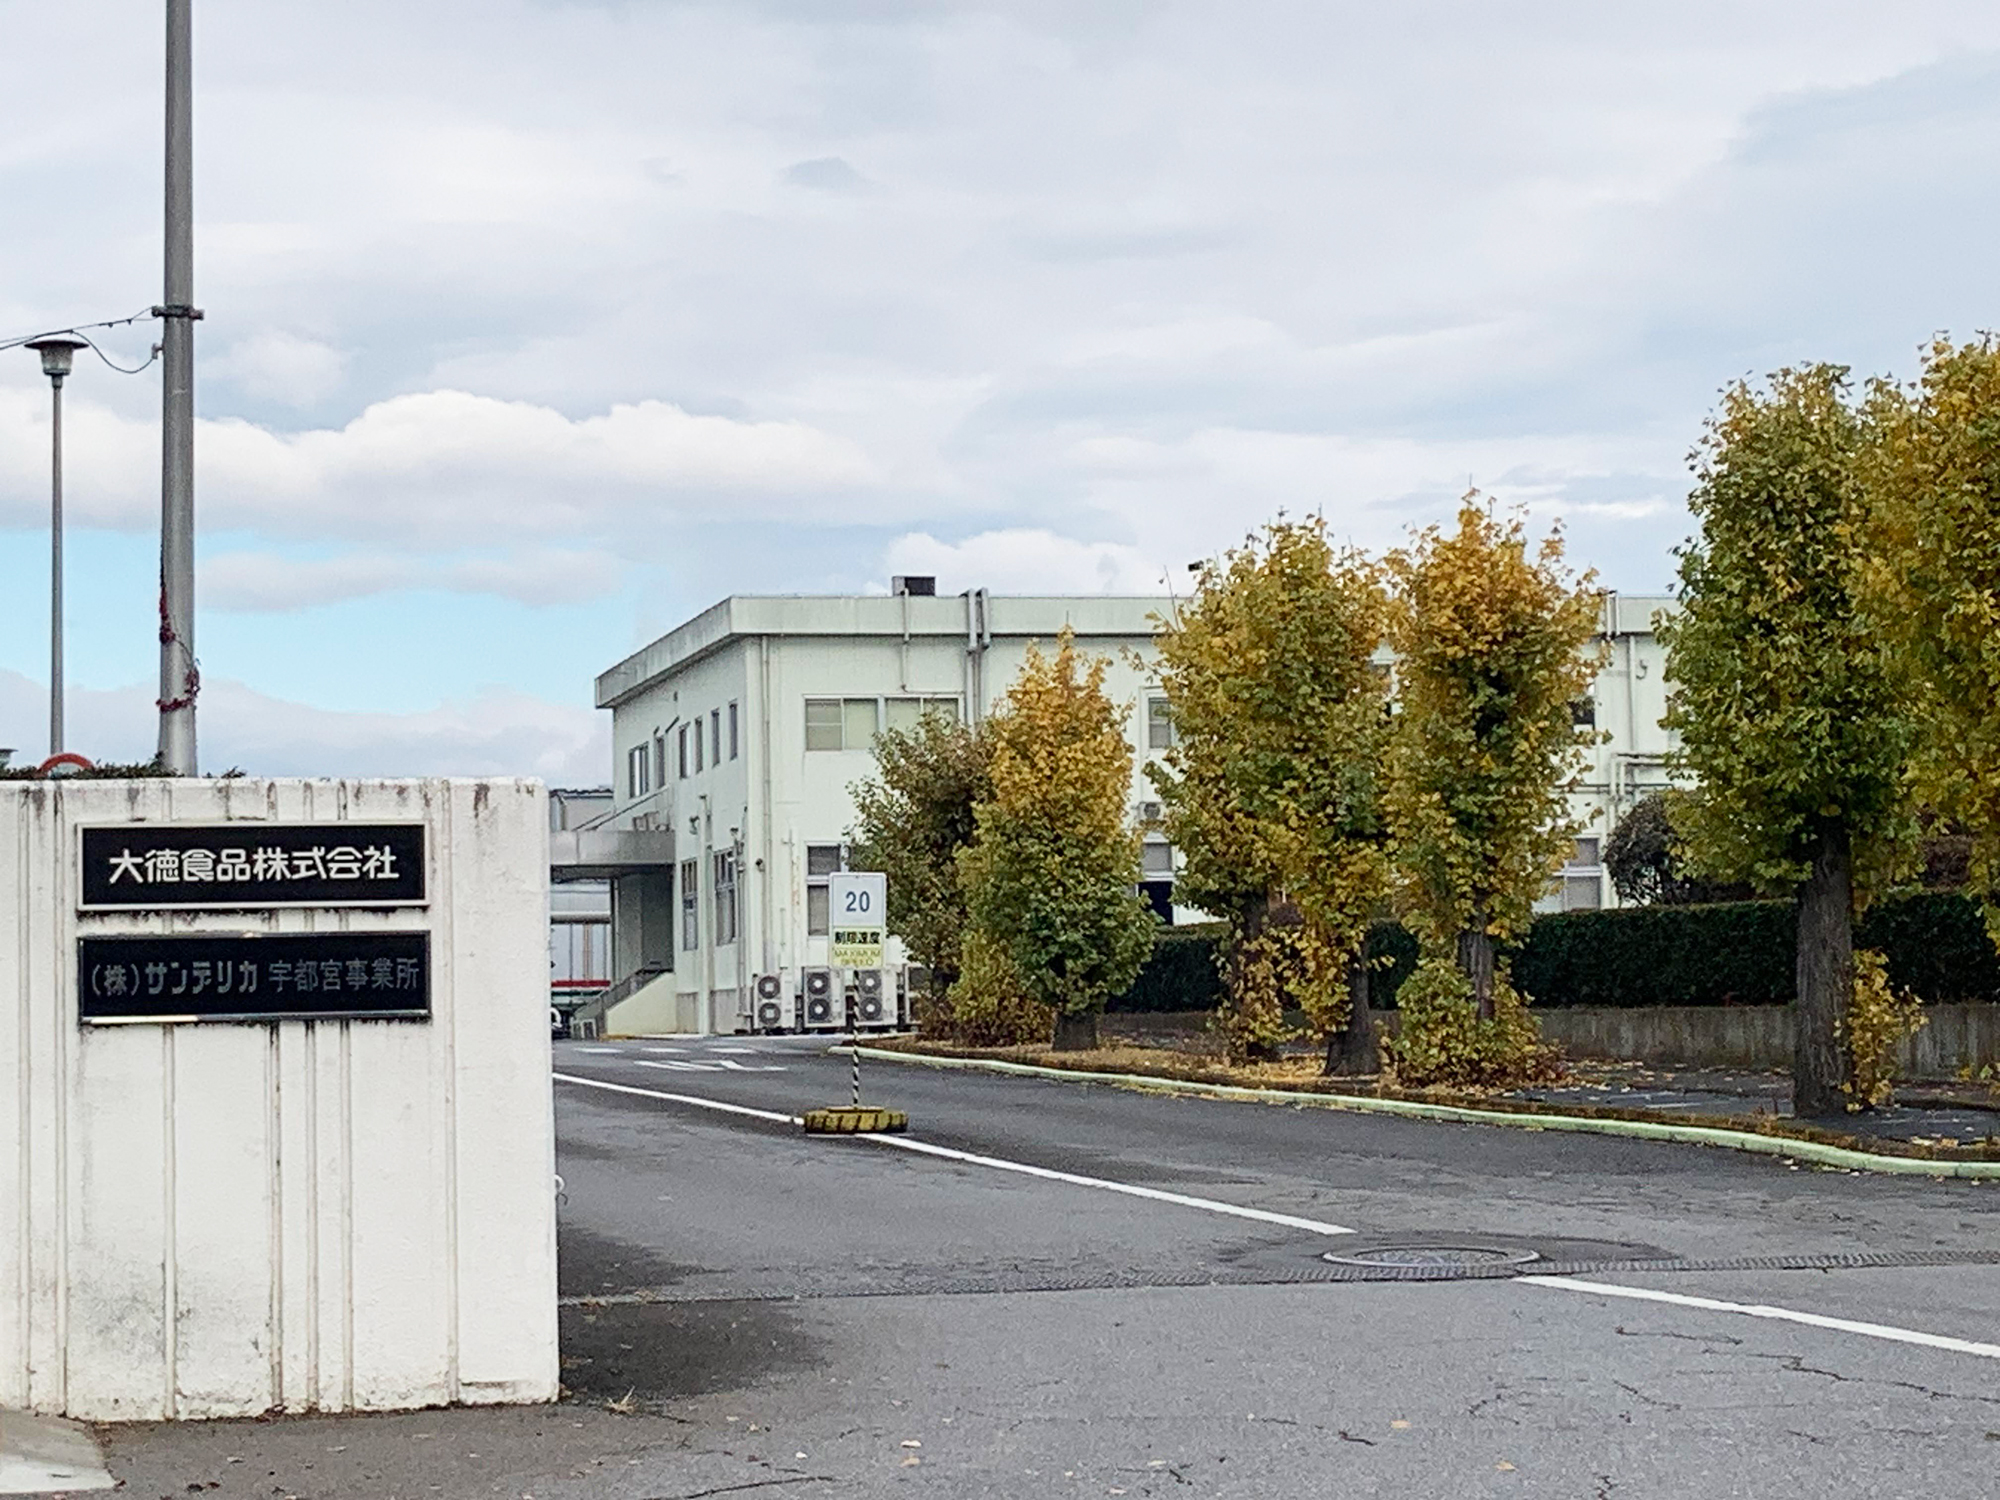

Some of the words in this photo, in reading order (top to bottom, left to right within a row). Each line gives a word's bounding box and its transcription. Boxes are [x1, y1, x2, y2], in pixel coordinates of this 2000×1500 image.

[109, 846, 400, 884] 大徳食品株式会社
[845, 891, 870, 912] 20
[268, 957, 421, 993] 宇都宮事業所
